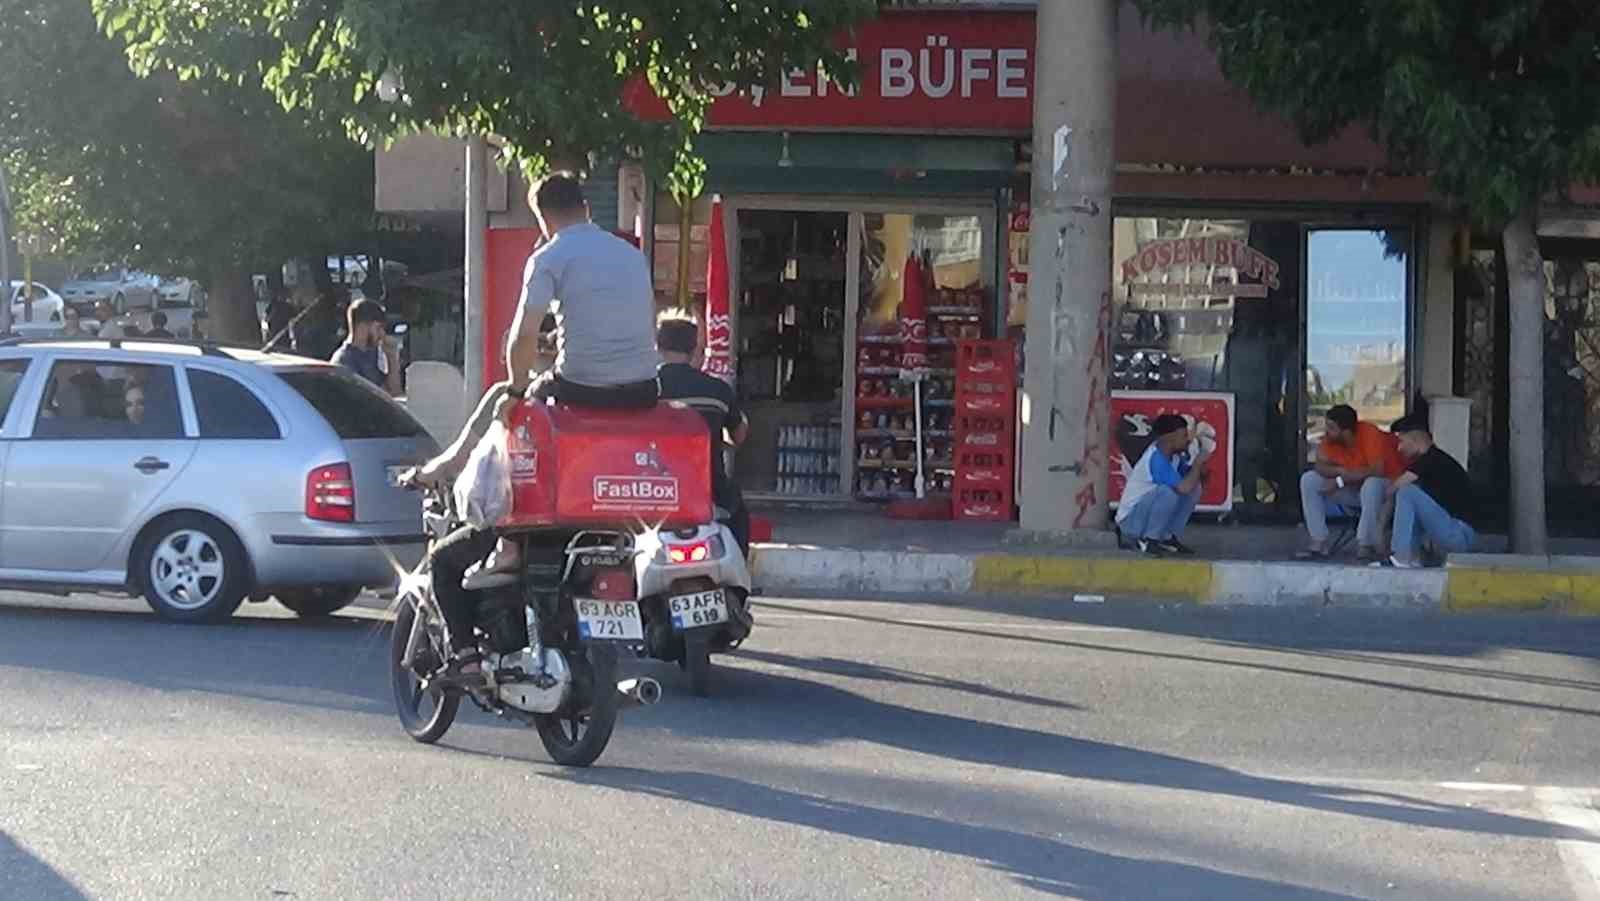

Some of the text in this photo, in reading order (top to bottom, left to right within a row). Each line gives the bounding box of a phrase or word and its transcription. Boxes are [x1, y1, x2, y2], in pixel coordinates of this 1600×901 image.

[880, 35, 1028, 98] BÜFE
[597, 481, 675, 498] FastBox
[671, 590, 725, 613] 63 AFR
[579, 602, 637, 618] 63 AGR
[692, 608, 719, 624] 619
[596, 620, 624, 635] 721
